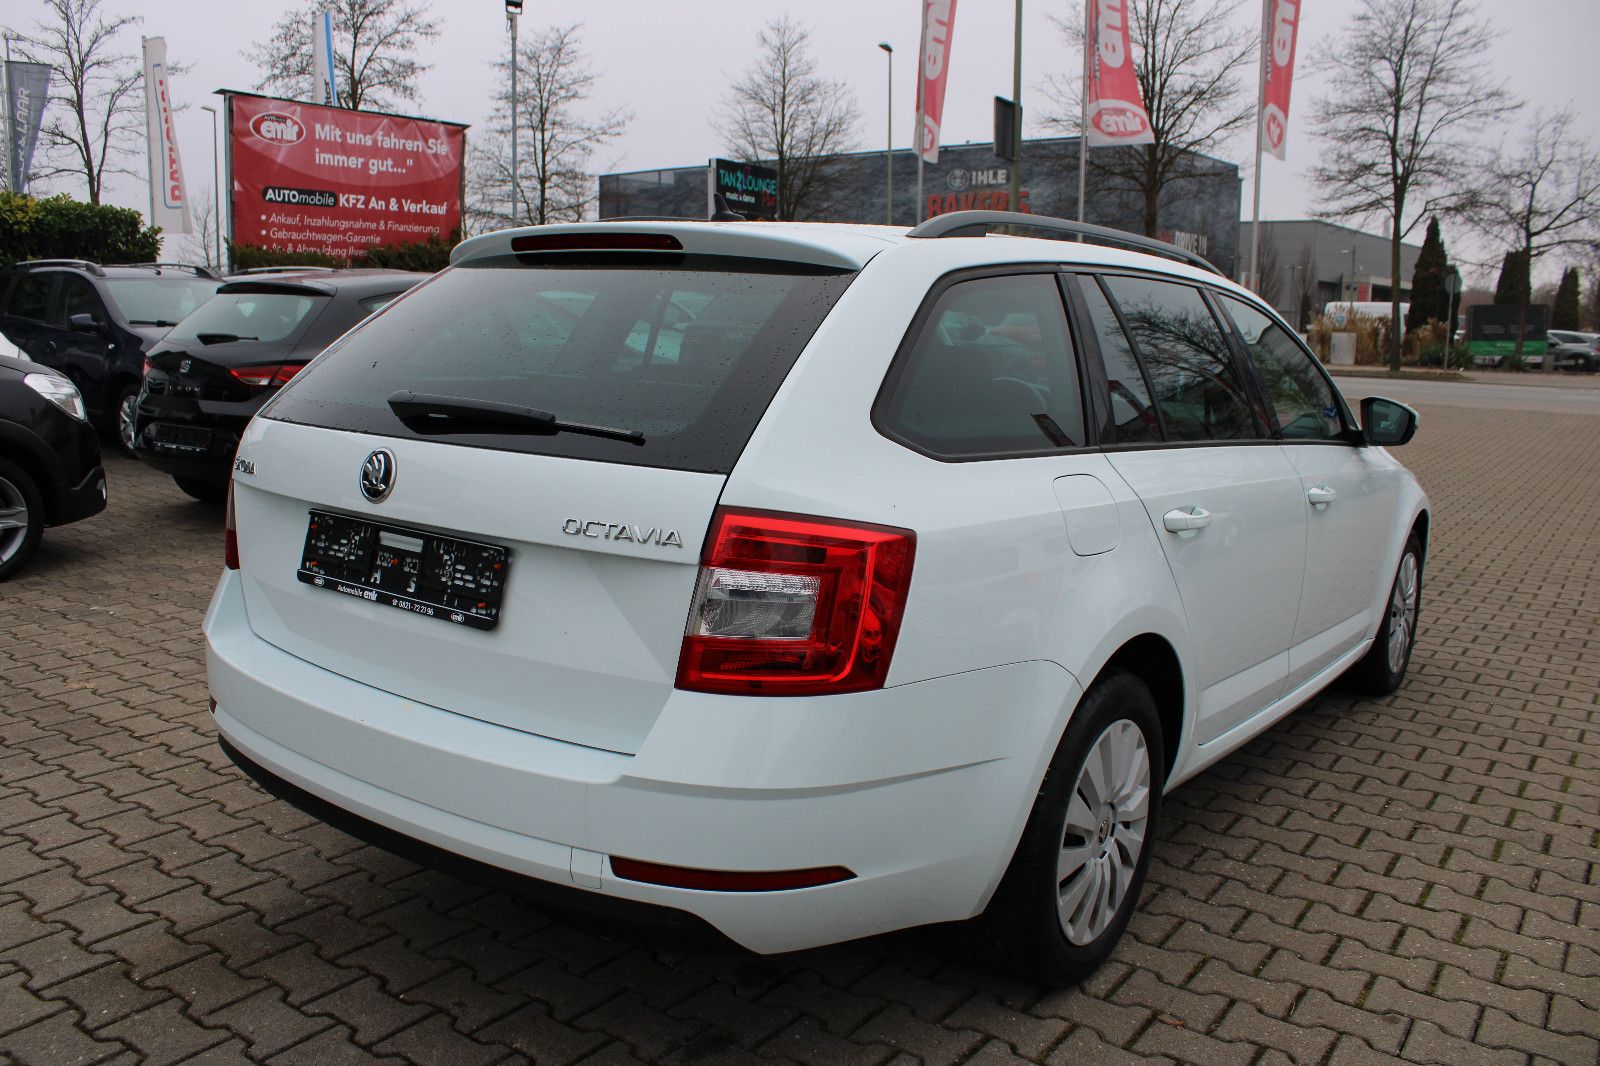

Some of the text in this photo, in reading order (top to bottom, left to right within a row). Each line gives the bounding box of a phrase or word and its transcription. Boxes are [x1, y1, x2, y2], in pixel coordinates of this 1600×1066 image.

[260, 119, 299, 141] emir
[315, 123, 448, 156] Mit uns fahren Sie
[315, 148, 364, 168] immer
[971, 168, 1007, 186] IHLE
[265, 188, 448, 216] AUTOmobile KFZ An & Verkauf
[270, 213, 440, 235] Ankauf, Inzahlungsnahme & Finanzierung
[270, 228, 381, 244] Gebrauchtwagen-Garantie
[562, 517, 683, 549] OCTAVIA
[363, 590, 378, 601] emir
